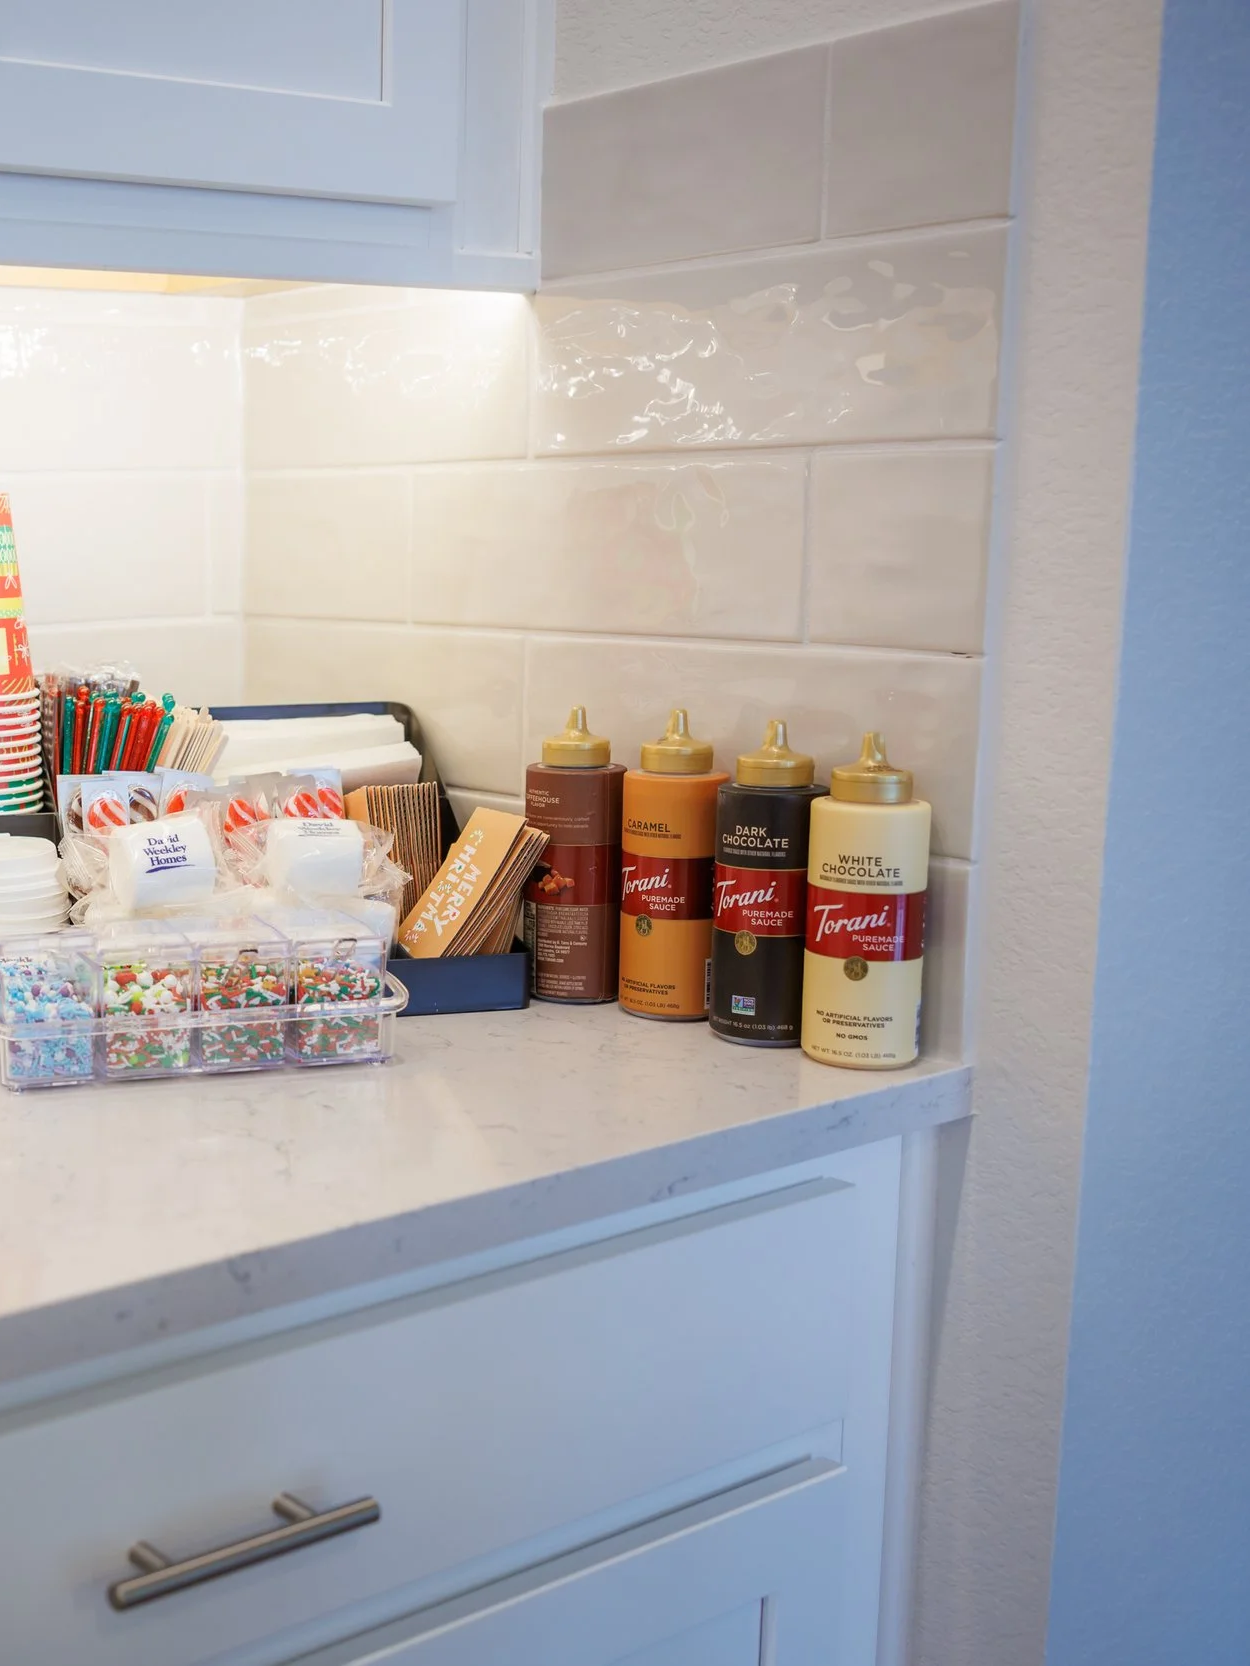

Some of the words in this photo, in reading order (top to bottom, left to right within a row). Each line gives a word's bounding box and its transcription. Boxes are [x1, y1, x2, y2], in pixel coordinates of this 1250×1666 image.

[628, 819, 670, 832] CARAMEL
[736, 825, 767, 837] DARK
[722, 834, 789, 848] CHOCOLATE
[143, 844, 187, 856] Weekley
[150, 855, 188, 867] Homes
[838, 854, 882, 867] WHITE
[822, 863, 900, 878] CHOCOLATE
[622, 866, 670, 901] Torani
[642, 894, 685, 904] PUREMADE
[716, 880, 776, 917] Torani
[650, 902, 676, 911] SAUCE
[742, 910, 794, 918] PUREMADE
[750, 918, 783, 926] SAUCE
[814, 903, 889, 942] Torani
[852, 934, 904, 944] PUREMADE
[862, 943, 895, 952] SAUCE
[626, 978, 649, 988] ARTIFICIAL
[629, 986, 668, 996] PRESERVATIVES
[826, 1012, 861, 1022] ARTIFICIAL
[832, 1020, 885, 1028] PRESERVATIVES
